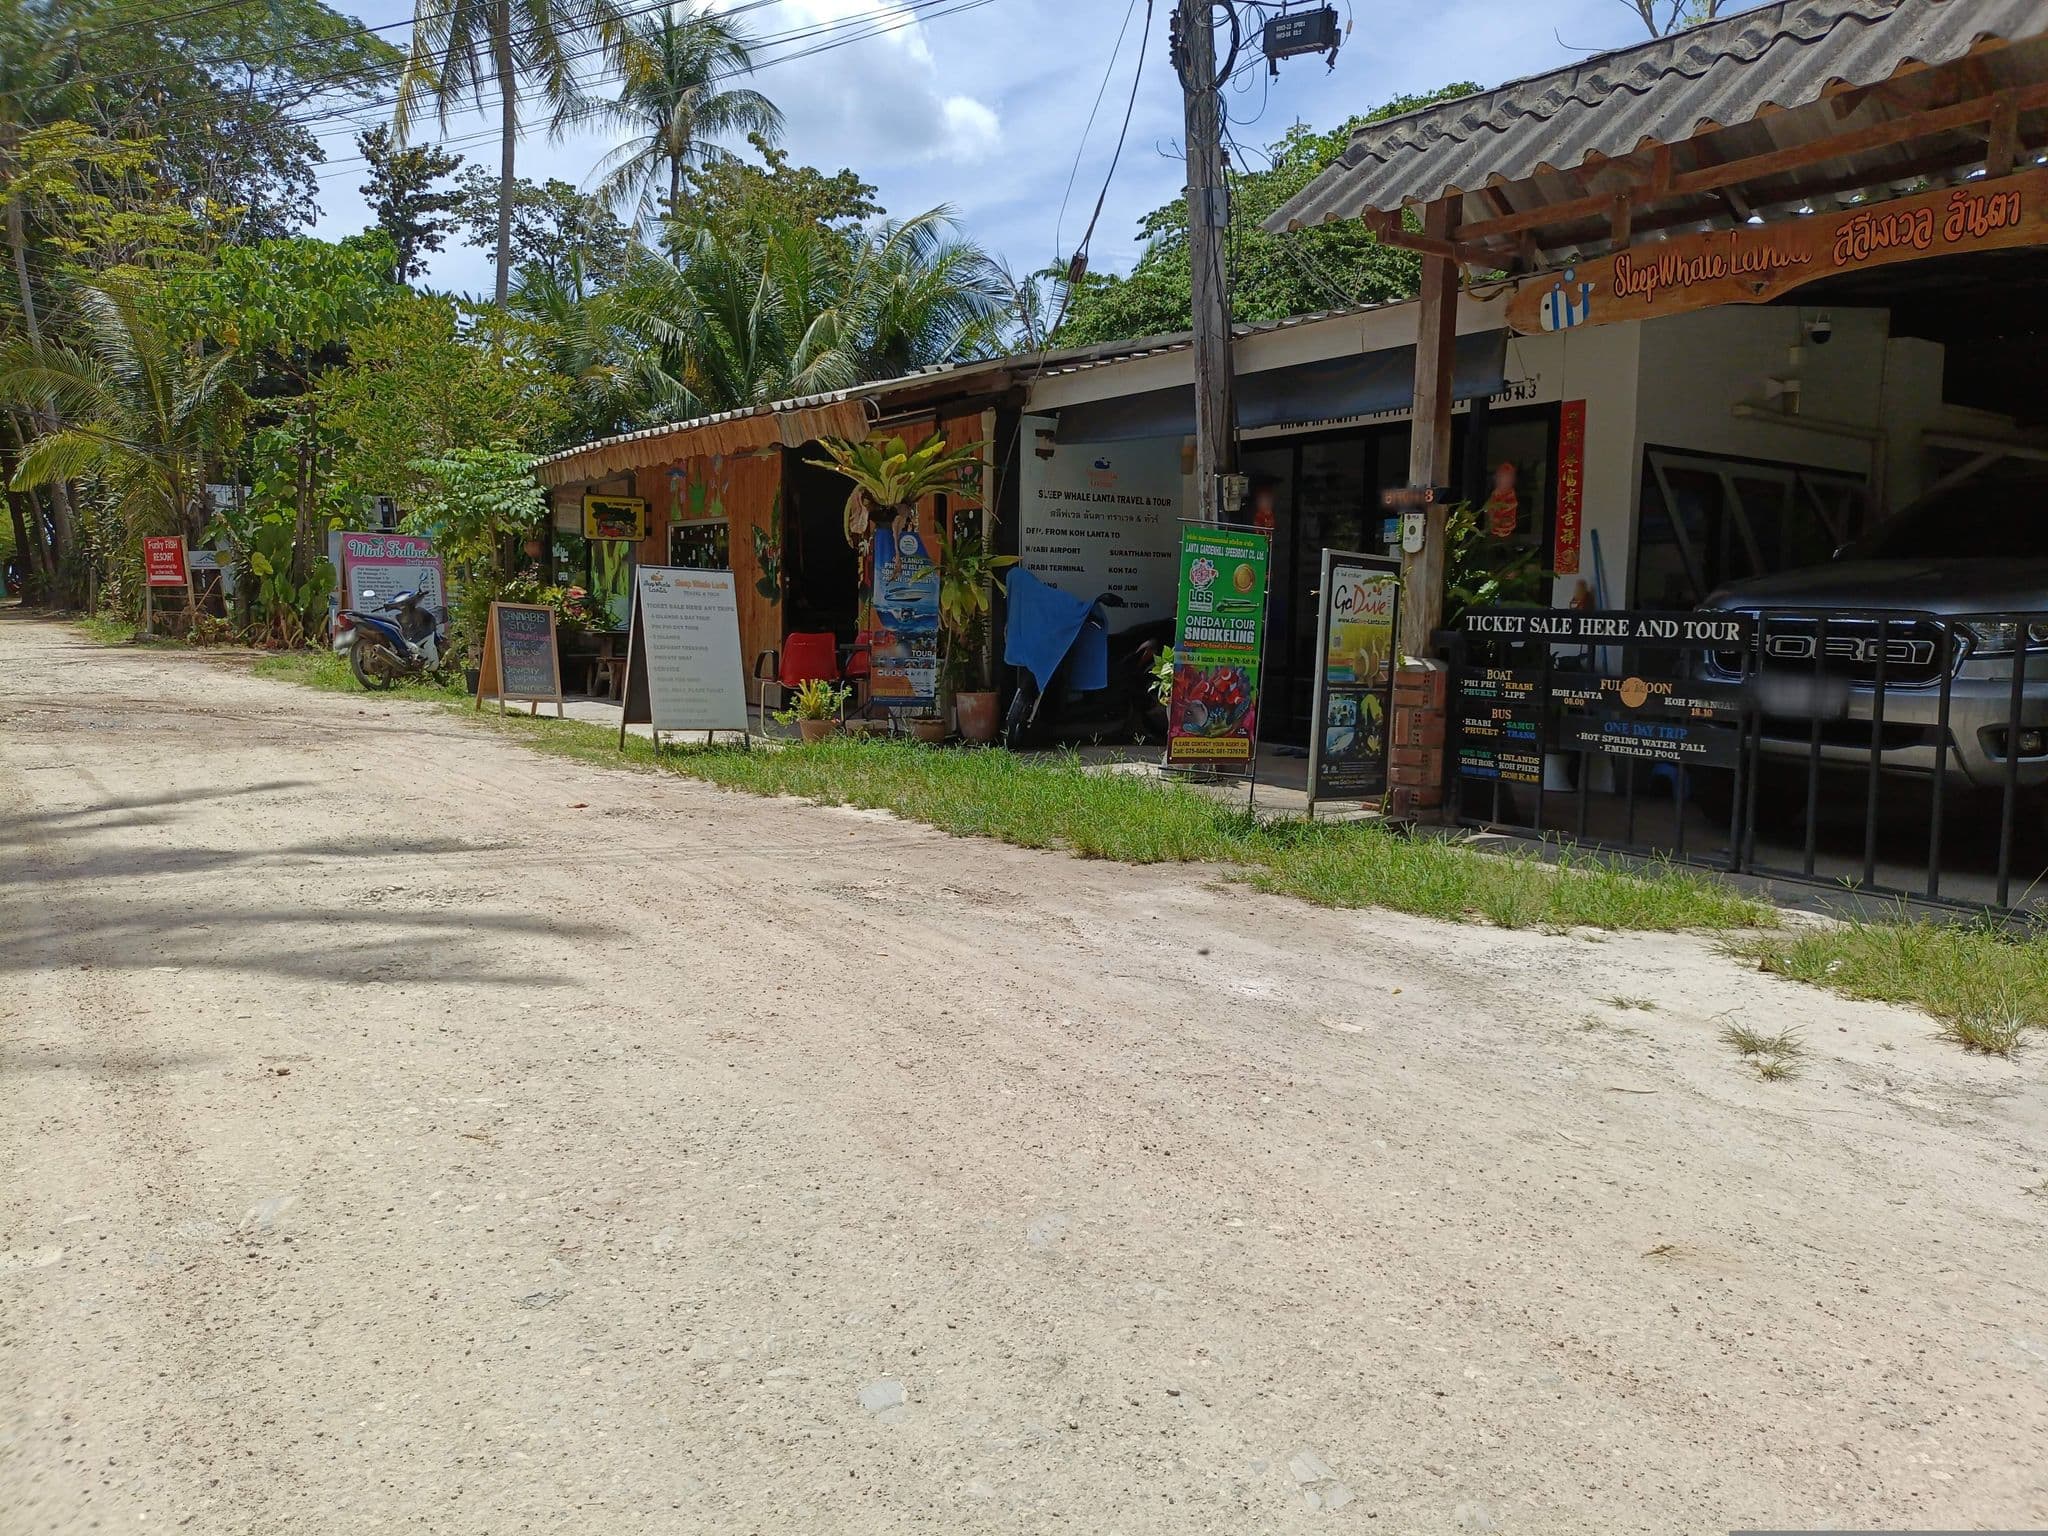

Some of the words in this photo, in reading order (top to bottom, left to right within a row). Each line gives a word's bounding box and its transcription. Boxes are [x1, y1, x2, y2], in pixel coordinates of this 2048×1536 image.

[1943, 190, 2021, 242] ลันตา
[1064, 491, 1091, 502] WHALE
[1092, 493, 1116, 504] LANTA
[1117, 495, 1144, 505] TRAVEL
[1152, 497, 1171, 507] TOUR
[1045, 528, 1068, 538] FROM
[1069, 529, 1085, 539] KOH
[1086, 530, 1110, 539] LANTA
[1111, 531, 1121, 539] TO
[348, 538, 385, 558] Mint
[387, 540, 439, 558] Fullne
[1049, 546, 1081, 555] AIRPORT
[153, 552, 174, 561] RESORT
[1152, 551, 1172, 559] TOWN
[1028, 564, 1048, 572] RABI
[1049, 564, 1086, 573] TERMINAL
[1189, 589, 1213, 603] LGS
[501, 611, 546, 623] CANNABIS
[1185, 615, 1227, 628] ONEDAY
[1230, 618, 1255, 630] TOUR
[1466, 615, 1525, 633] TICKET
[1529, 617, 1572, 635] SALE
[1578, 618, 1629, 637] HERE
[1635, 621, 1678, 638] AND
[1683, 621, 1740, 641] TOUR
[1184, 627, 1255, 643] SNORKELING
[1752, 633, 1936, 665] ORD
[1486, 669, 1513, 680] BOAT
[1505, 682, 1534, 691] KRABI
[1463, 688, 1498, 697] PHUKET
[1504, 691, 1526, 699] LIPE
[1552, 688, 1570, 698] KOH
[1571, 689, 1603, 700] LANTA
[1664, 697, 1687, 707] KOH
[1491, 708, 1512, 720] BUS
[1465, 718, 1492, 727] KRABI
[1506, 721, 1536, 730] SAMUI
[1465, 727, 1499, 736] PHUKET
[1604, 722, 1630, 734] ONE
[1633, 724, 1654, 736] DAY
[1659, 727, 1688, 740] TRIP
[1580, 732, 1600, 742] HOT
[1601, 734, 1638, 746] SPRING
[1642, 738, 1676, 749] WATER
[1680, 742, 1707, 753] FALL
[1604, 745, 1652, 757] EMERALD
[1654, 750, 1681, 760] POOL
[1461, 757, 1478, 765] KOH
[1478, 758, 1495, 768] ROK
[1498, 762, 1515, 770] KOH
[1502, 754, 1540, 765] ISLANDS
